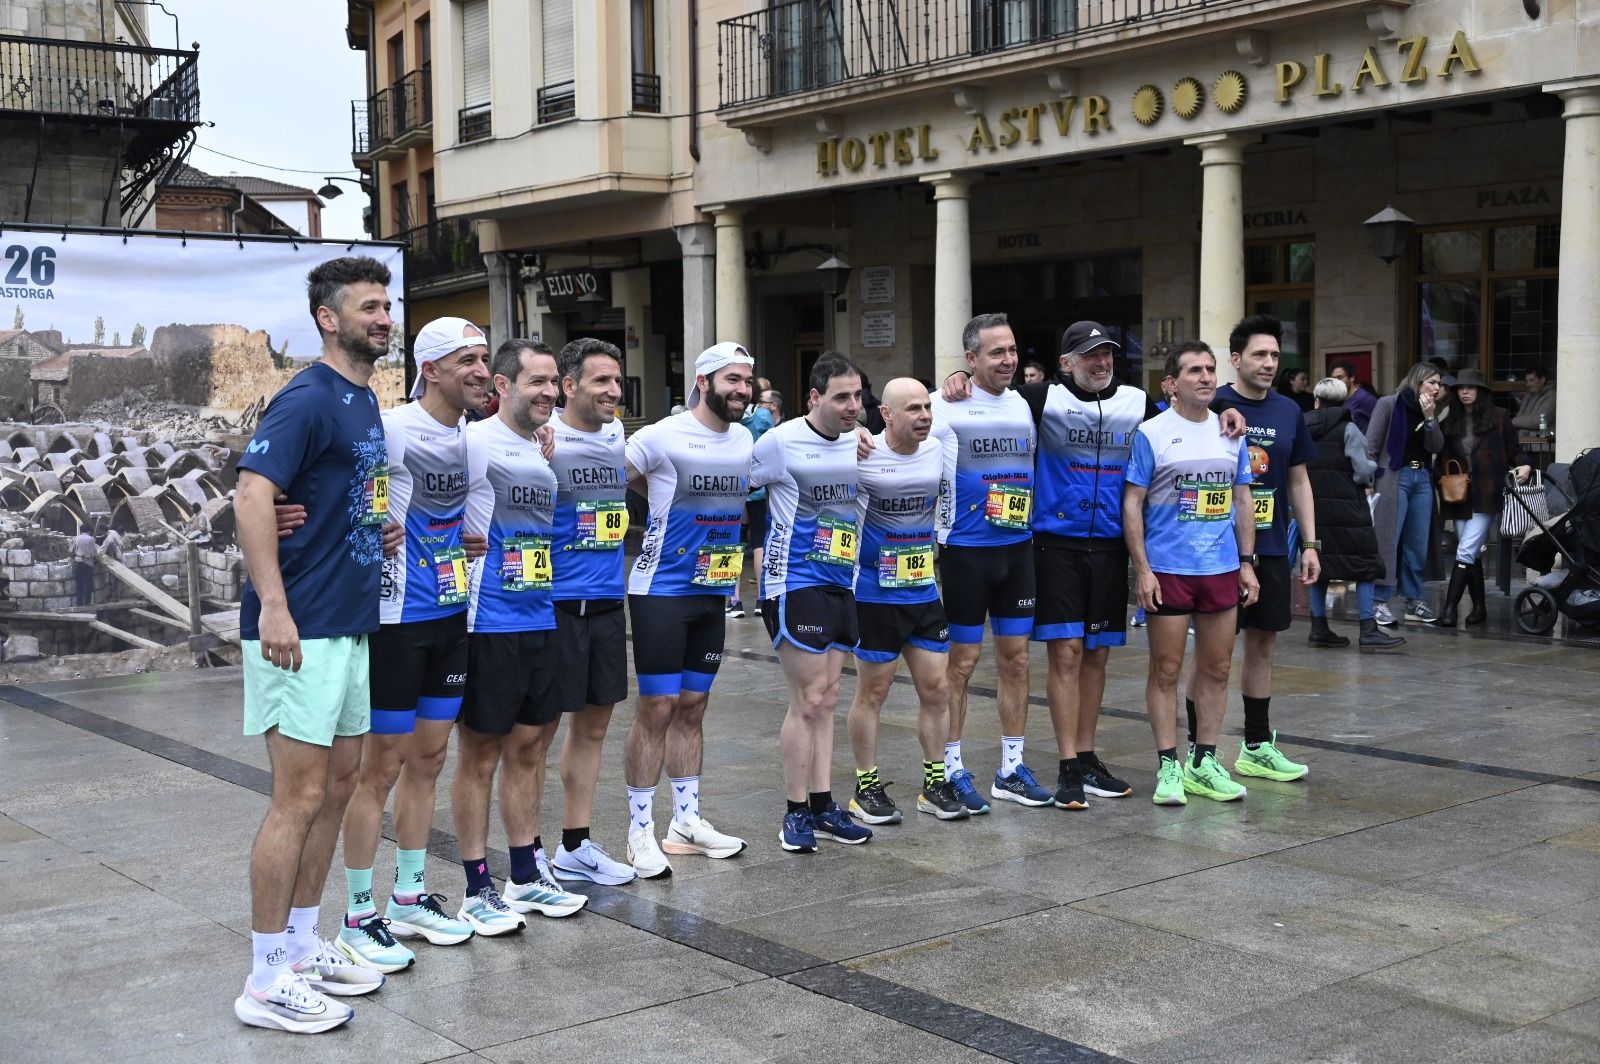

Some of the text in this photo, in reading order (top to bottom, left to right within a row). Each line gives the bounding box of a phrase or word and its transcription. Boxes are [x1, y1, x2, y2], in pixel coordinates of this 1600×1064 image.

[816, 124, 939, 177] HOTEL
[1274, 29, 1482, 105] PLAZA
[1476, 185, 1550, 208] PLAZA
[997, 233, 1042, 250] HOTEL
[5, 245, 56, 286] 26
[0, 287, 55, 299] ASTORGA
[1246, 426, 1266, 435] PAÑA
[1009, 496, 1026, 512] 646
[1206, 492, 1226, 505] 165
[606, 513, 621, 528] 88
[841, 532, 852, 549] 92
[718, 555, 732, 568] 74
[906, 555, 925, 570] 182
